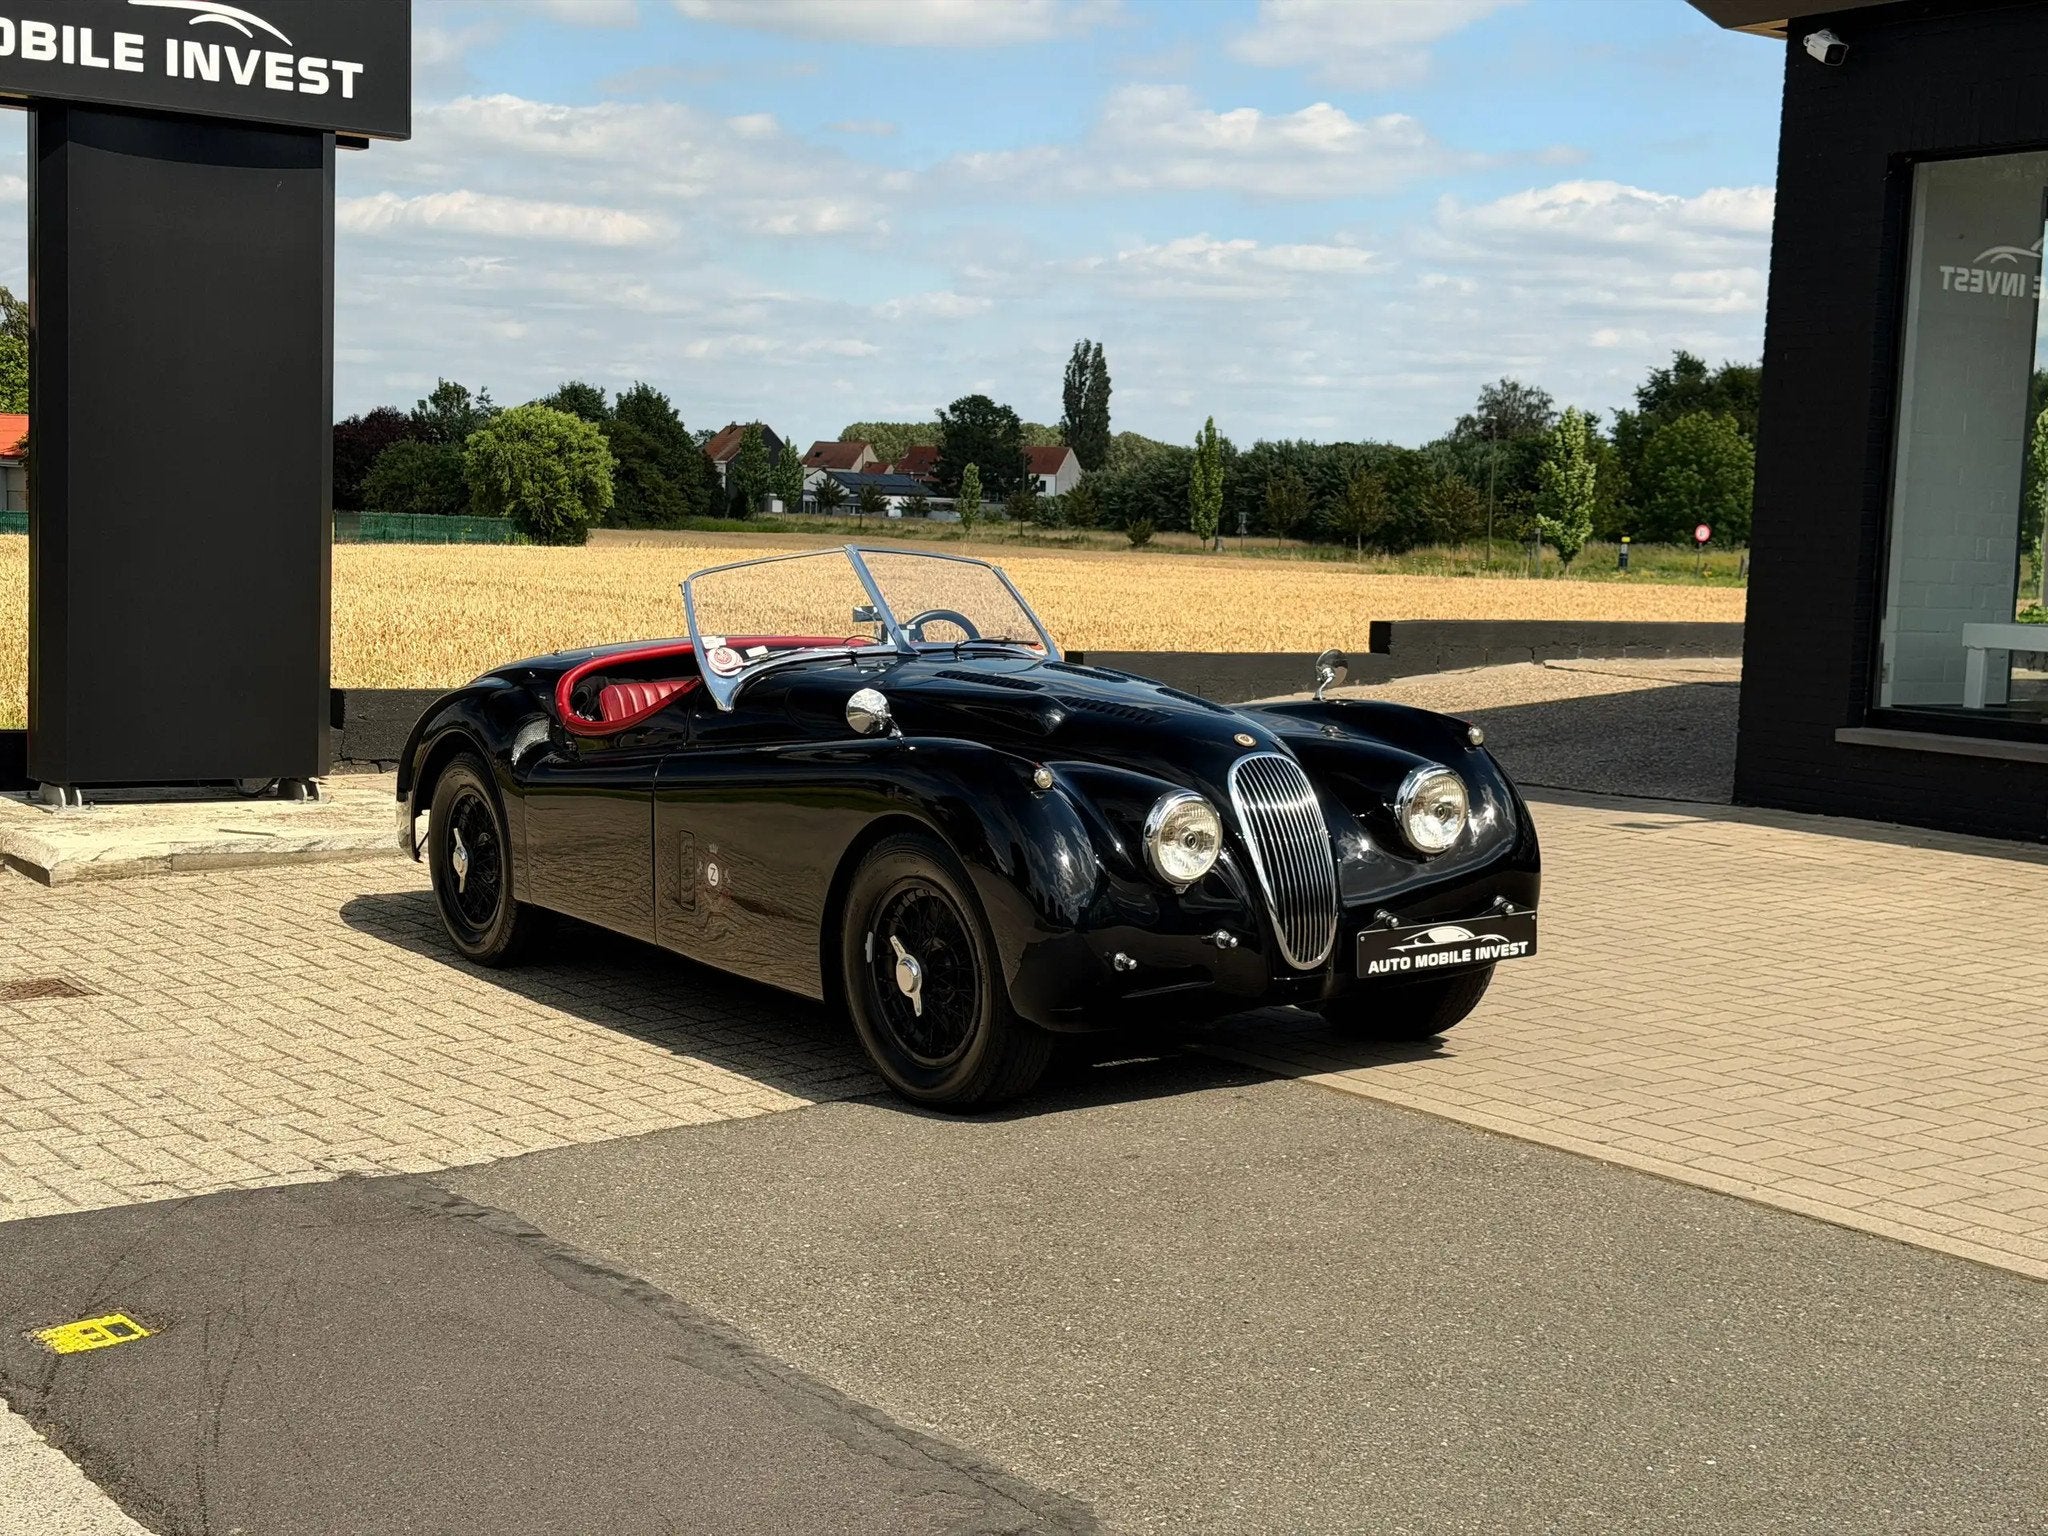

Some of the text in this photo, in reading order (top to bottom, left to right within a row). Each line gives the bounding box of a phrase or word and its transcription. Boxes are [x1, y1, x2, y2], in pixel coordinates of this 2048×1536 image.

[166, 38, 364, 99] INVEST
[1367, 941, 1529, 974] AUTO MOBILE INVEST
